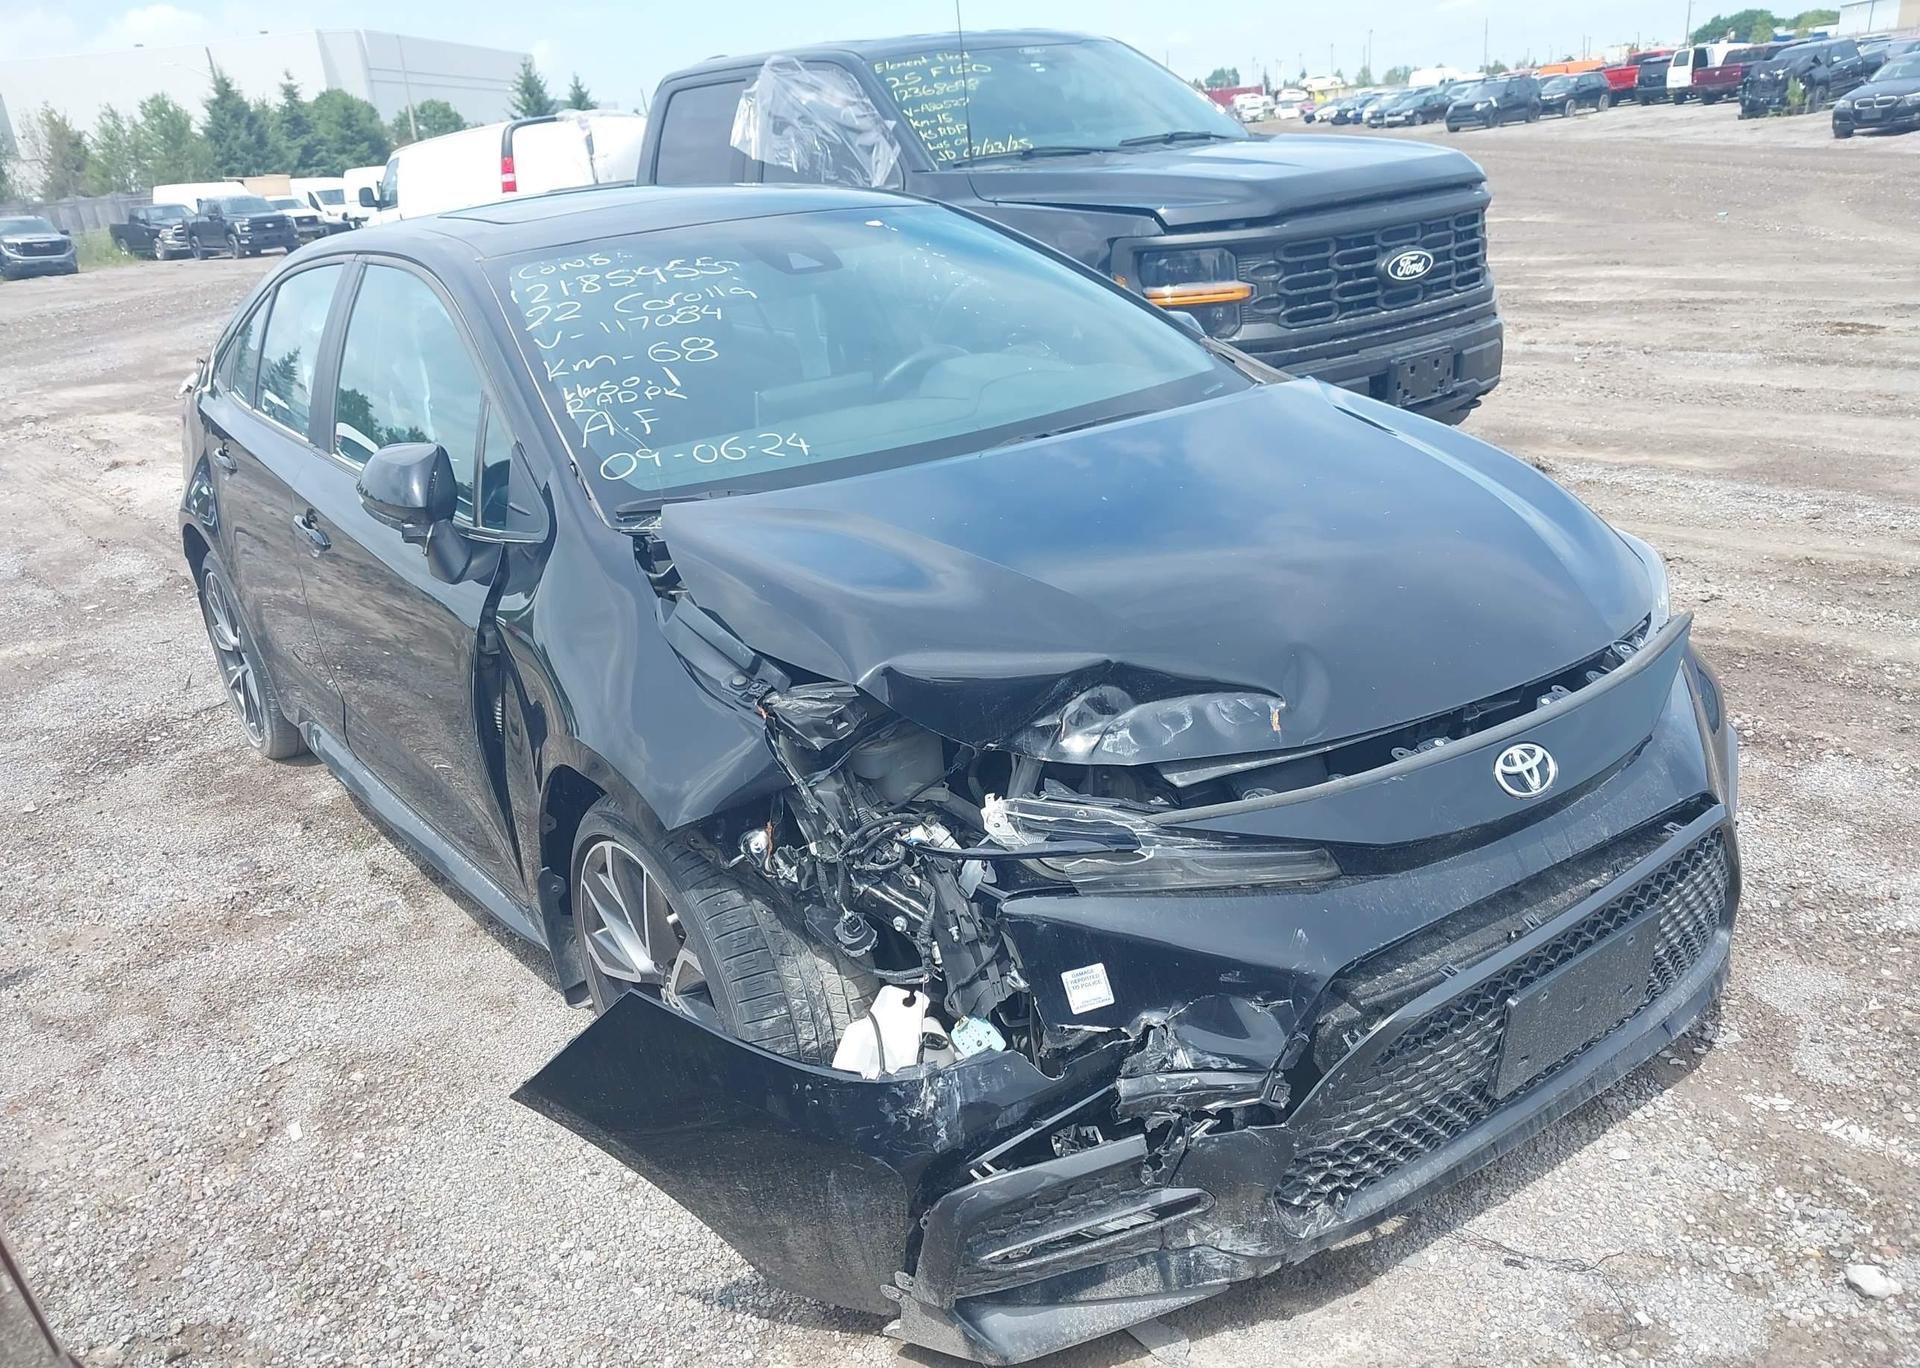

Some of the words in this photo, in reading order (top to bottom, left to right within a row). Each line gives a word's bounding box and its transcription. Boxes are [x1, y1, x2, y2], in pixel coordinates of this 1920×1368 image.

[886, 72, 922, 88] 25
[1397, 255, 1425, 276] Ford
[525, 301, 583, 331] 22
[613, 283, 757, 313] Corolla
[600, 433, 811, 480] 09-06-24
